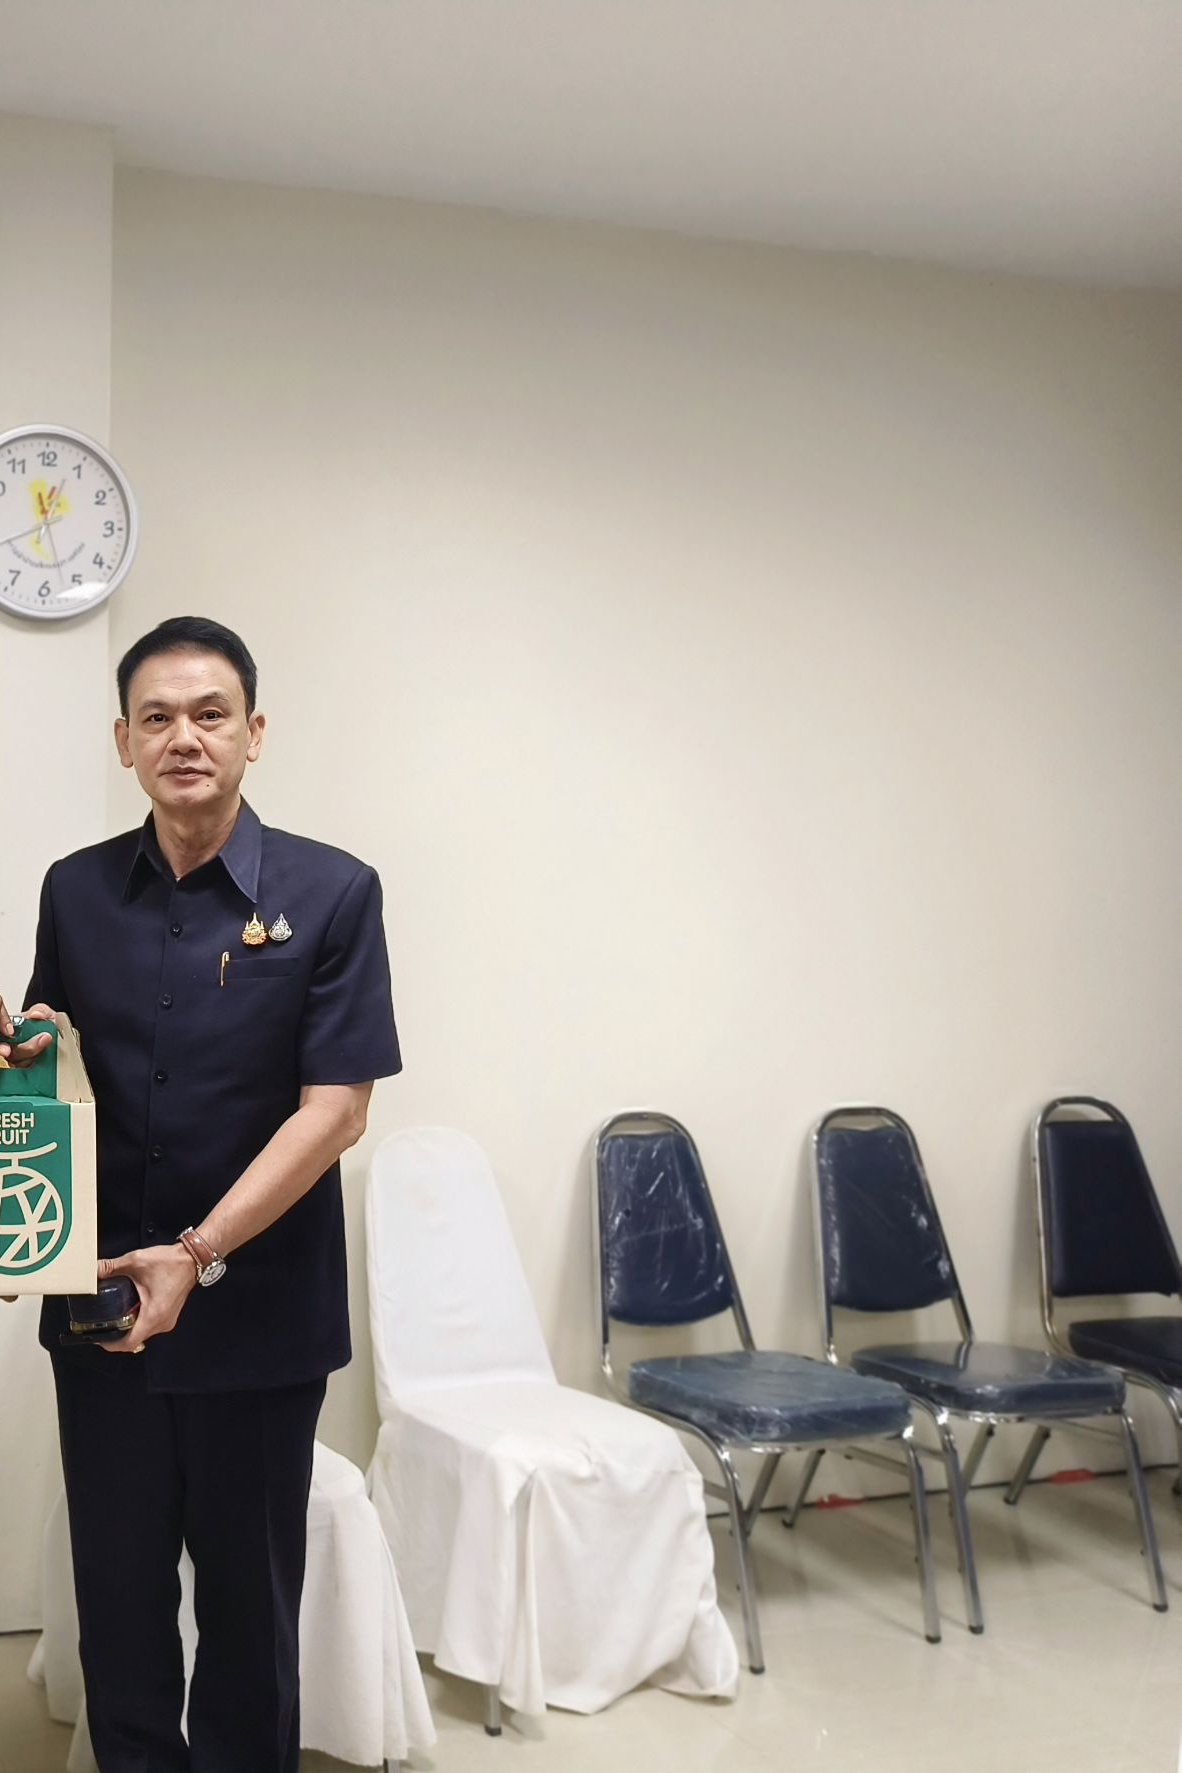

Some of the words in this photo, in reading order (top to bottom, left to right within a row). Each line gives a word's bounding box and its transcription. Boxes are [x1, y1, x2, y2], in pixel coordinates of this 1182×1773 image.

[7, 458, 26, 475] 11
[37, 451, 58, 467] 12
[72, 464, 83, 480] 1
[94, 490, 107, 506] 2
[102, 520, 115, 538] 3
[92, 552, 105, 569] 4
[8, 569, 22, 587] 7
[71, 574, 83, 586] 5
[37, 580, 51, 598] 6
